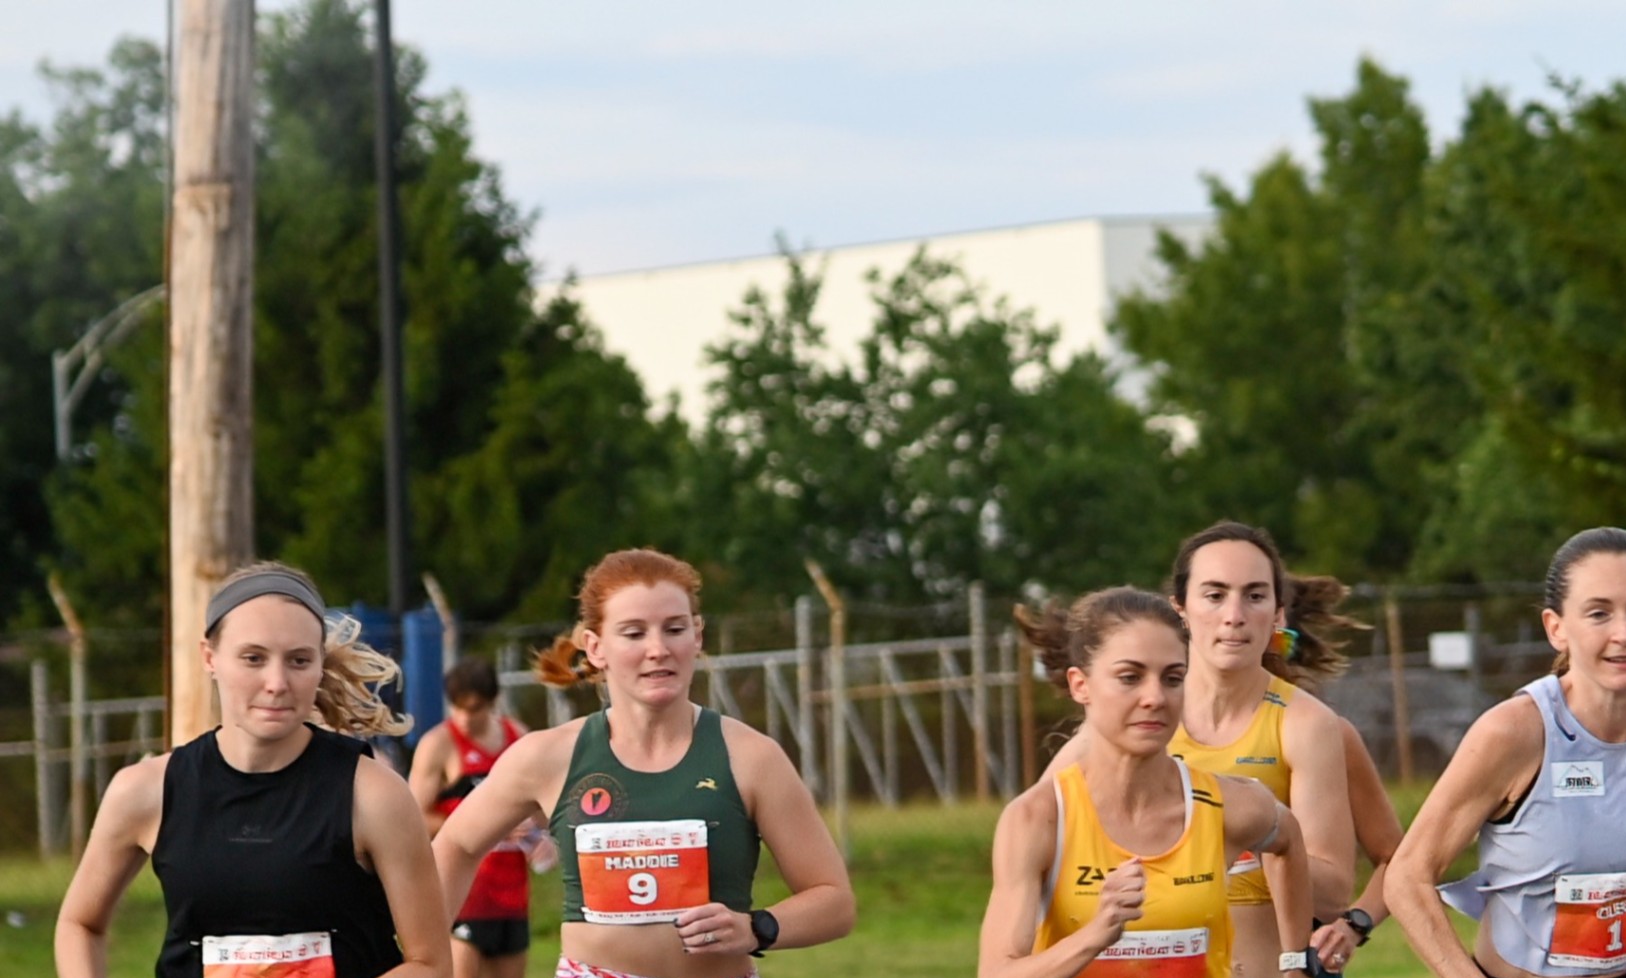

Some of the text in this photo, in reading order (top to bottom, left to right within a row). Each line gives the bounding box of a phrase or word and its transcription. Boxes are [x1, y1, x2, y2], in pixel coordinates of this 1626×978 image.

[604, 854, 679, 870] MADDIE
[627, 872, 658, 905] 9
[1606, 919, 1623, 951] 1
